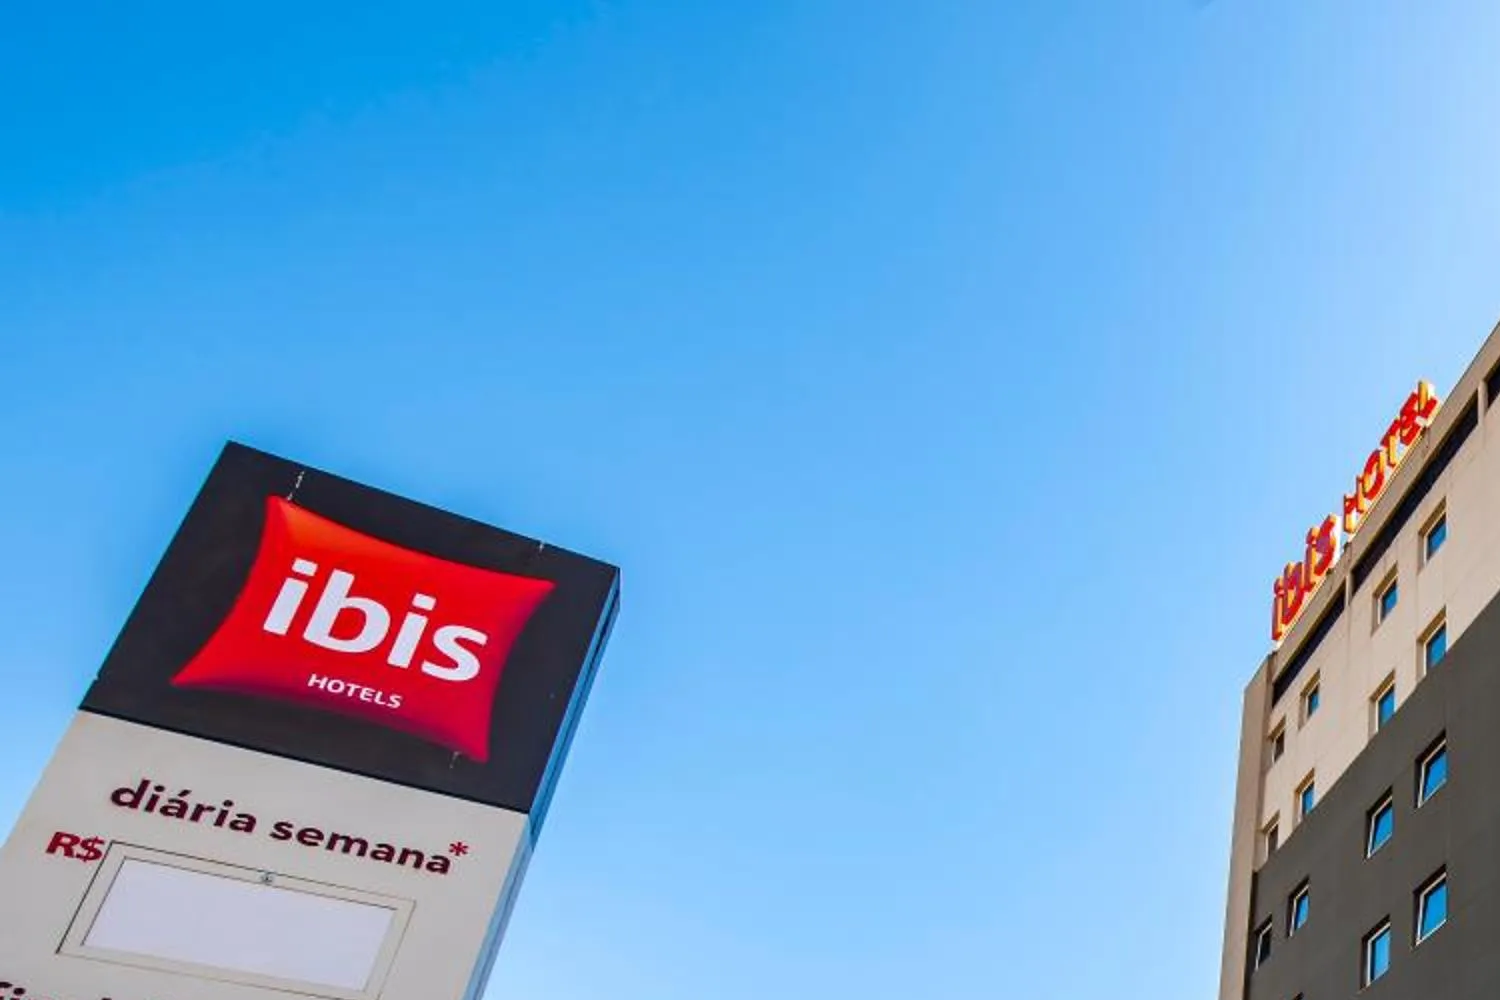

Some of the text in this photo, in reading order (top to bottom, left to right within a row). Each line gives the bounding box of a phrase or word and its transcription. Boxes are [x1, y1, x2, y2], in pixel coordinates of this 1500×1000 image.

[1271, 381, 1438, 641] ibis HOTEL
[263, 557, 488, 682] ibis
[308, 673, 403, 709] HOTELS
[110, 778, 257, 834] diária
[45, 831, 106, 863] R$
